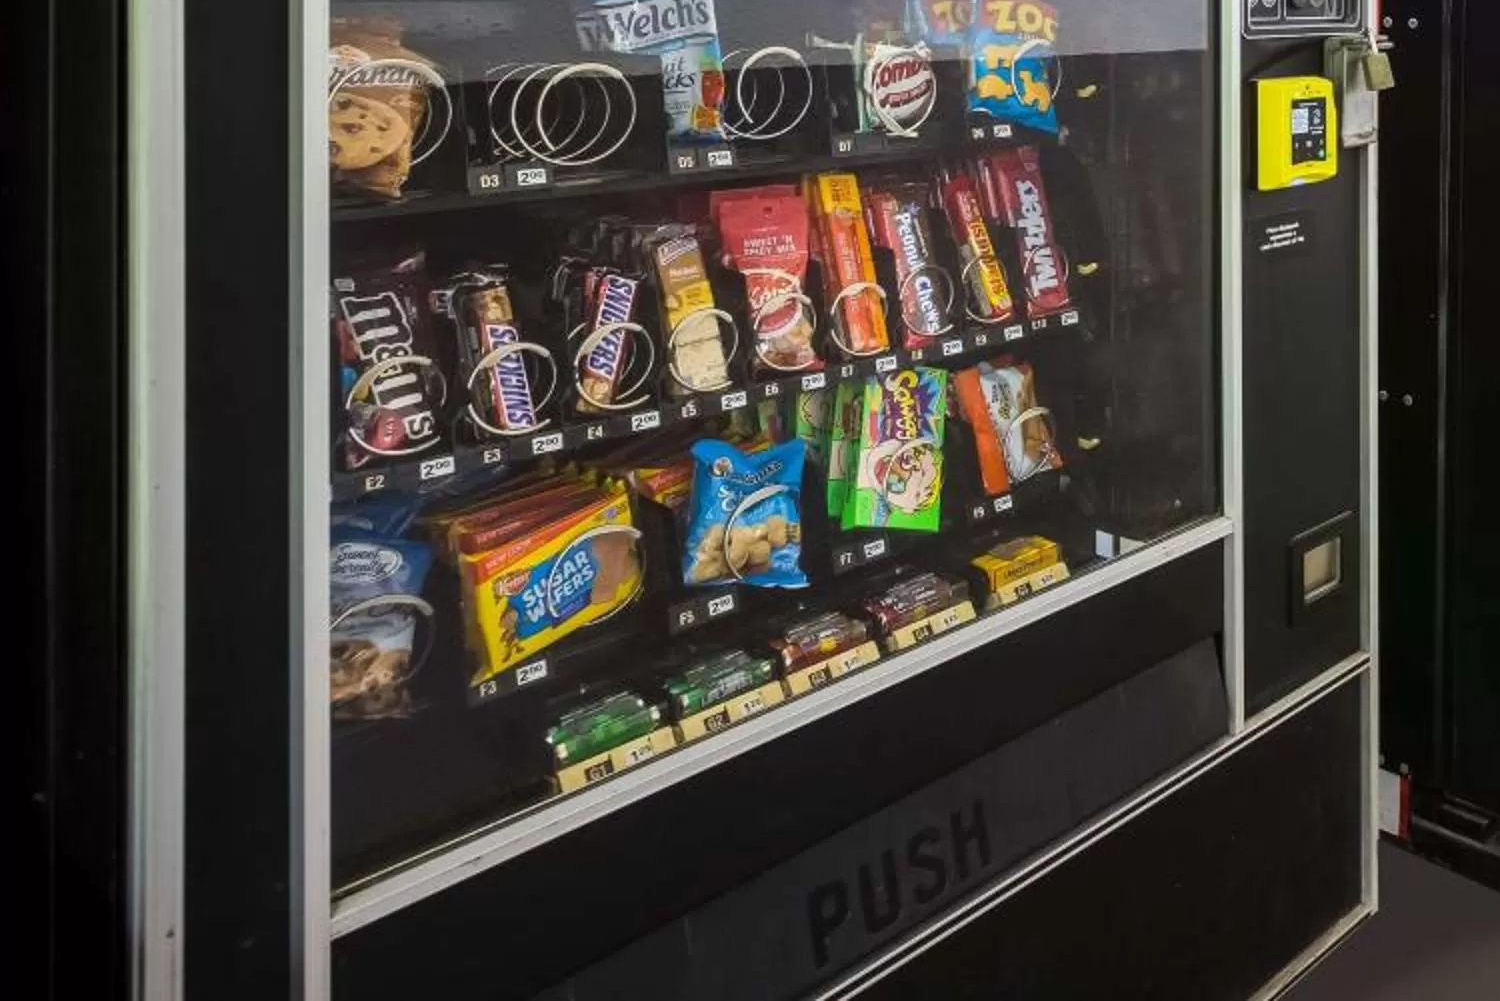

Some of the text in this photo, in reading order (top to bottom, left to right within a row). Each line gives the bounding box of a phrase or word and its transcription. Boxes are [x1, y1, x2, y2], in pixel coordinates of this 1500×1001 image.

[585, 275, 636, 376] SNICERS
[914, 275, 939, 335] Chews
[488, 326, 535, 427] SNICKS
[587, 427, 604, 440] E4
[365, 475, 384, 490] E2
[522, 551, 588, 609] SUGAR
[527, 566, 594, 622] WFERS
[807, 798, 991, 968] PUSH
